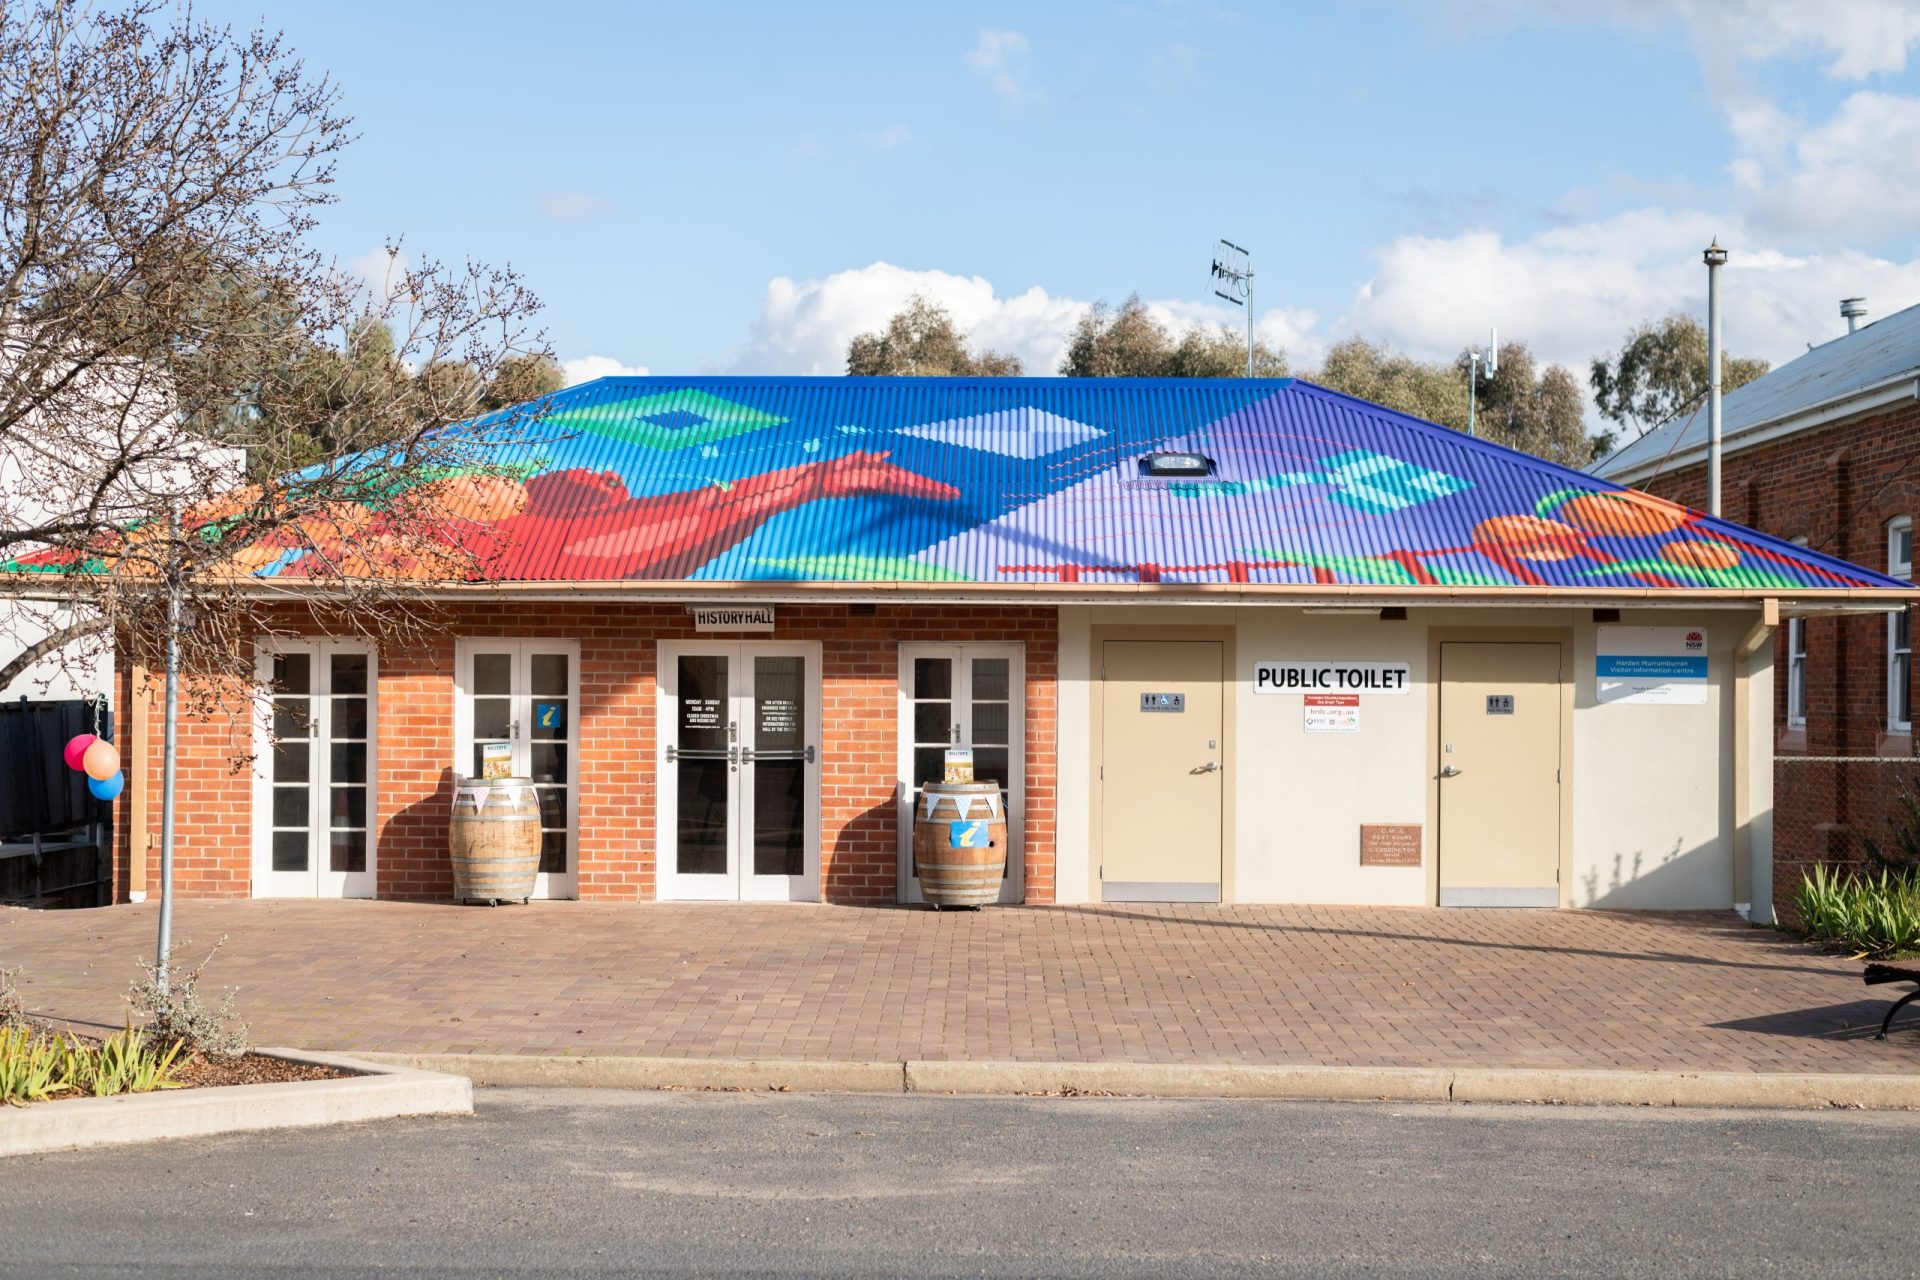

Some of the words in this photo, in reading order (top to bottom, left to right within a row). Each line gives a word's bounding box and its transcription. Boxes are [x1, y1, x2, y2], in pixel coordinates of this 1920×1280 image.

[698, 611, 745, 624] HISTORY
[745, 611, 773, 624] HALL
[1258, 668, 1331, 688] PUBLIC
[1335, 668, 1406, 689] TOILET
